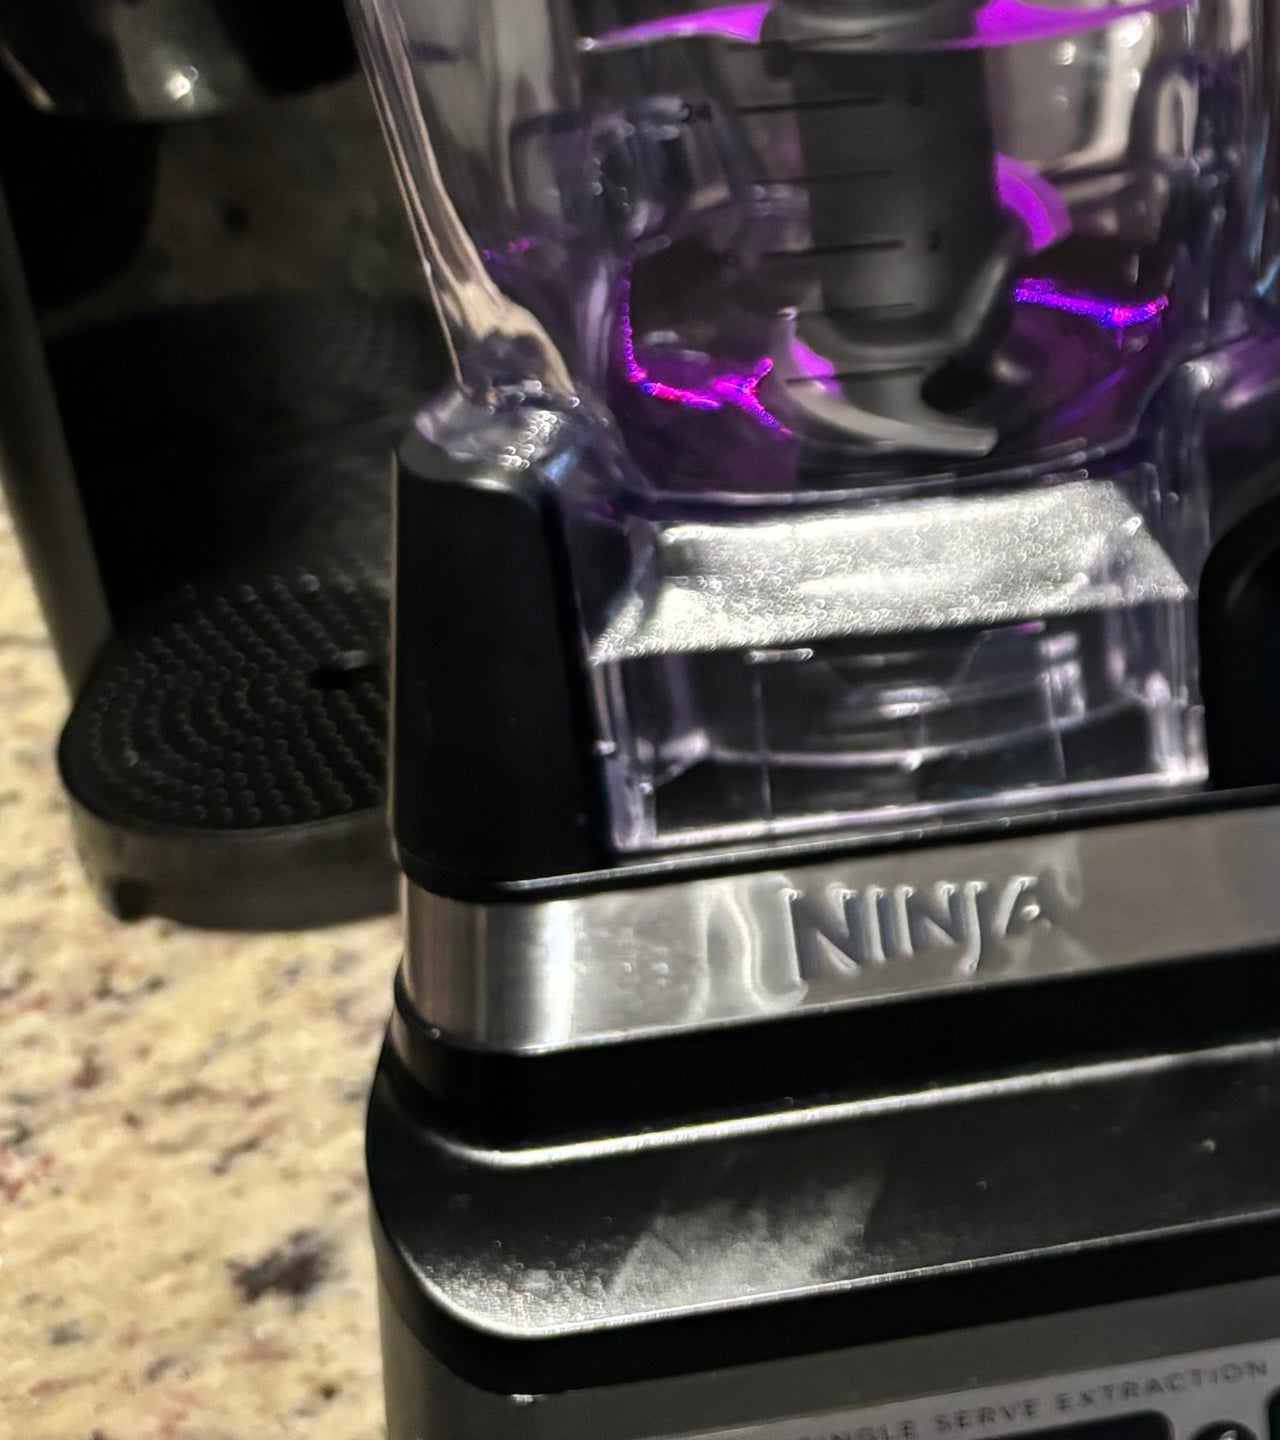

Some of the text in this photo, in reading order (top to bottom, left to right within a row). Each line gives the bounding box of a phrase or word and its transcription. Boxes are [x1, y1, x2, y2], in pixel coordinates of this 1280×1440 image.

[779, 873, 1053, 980] NINJA
[933, 1397, 1038, 1434] SERVE
[1054, 1359, 1268, 1411] EXTRACTION
